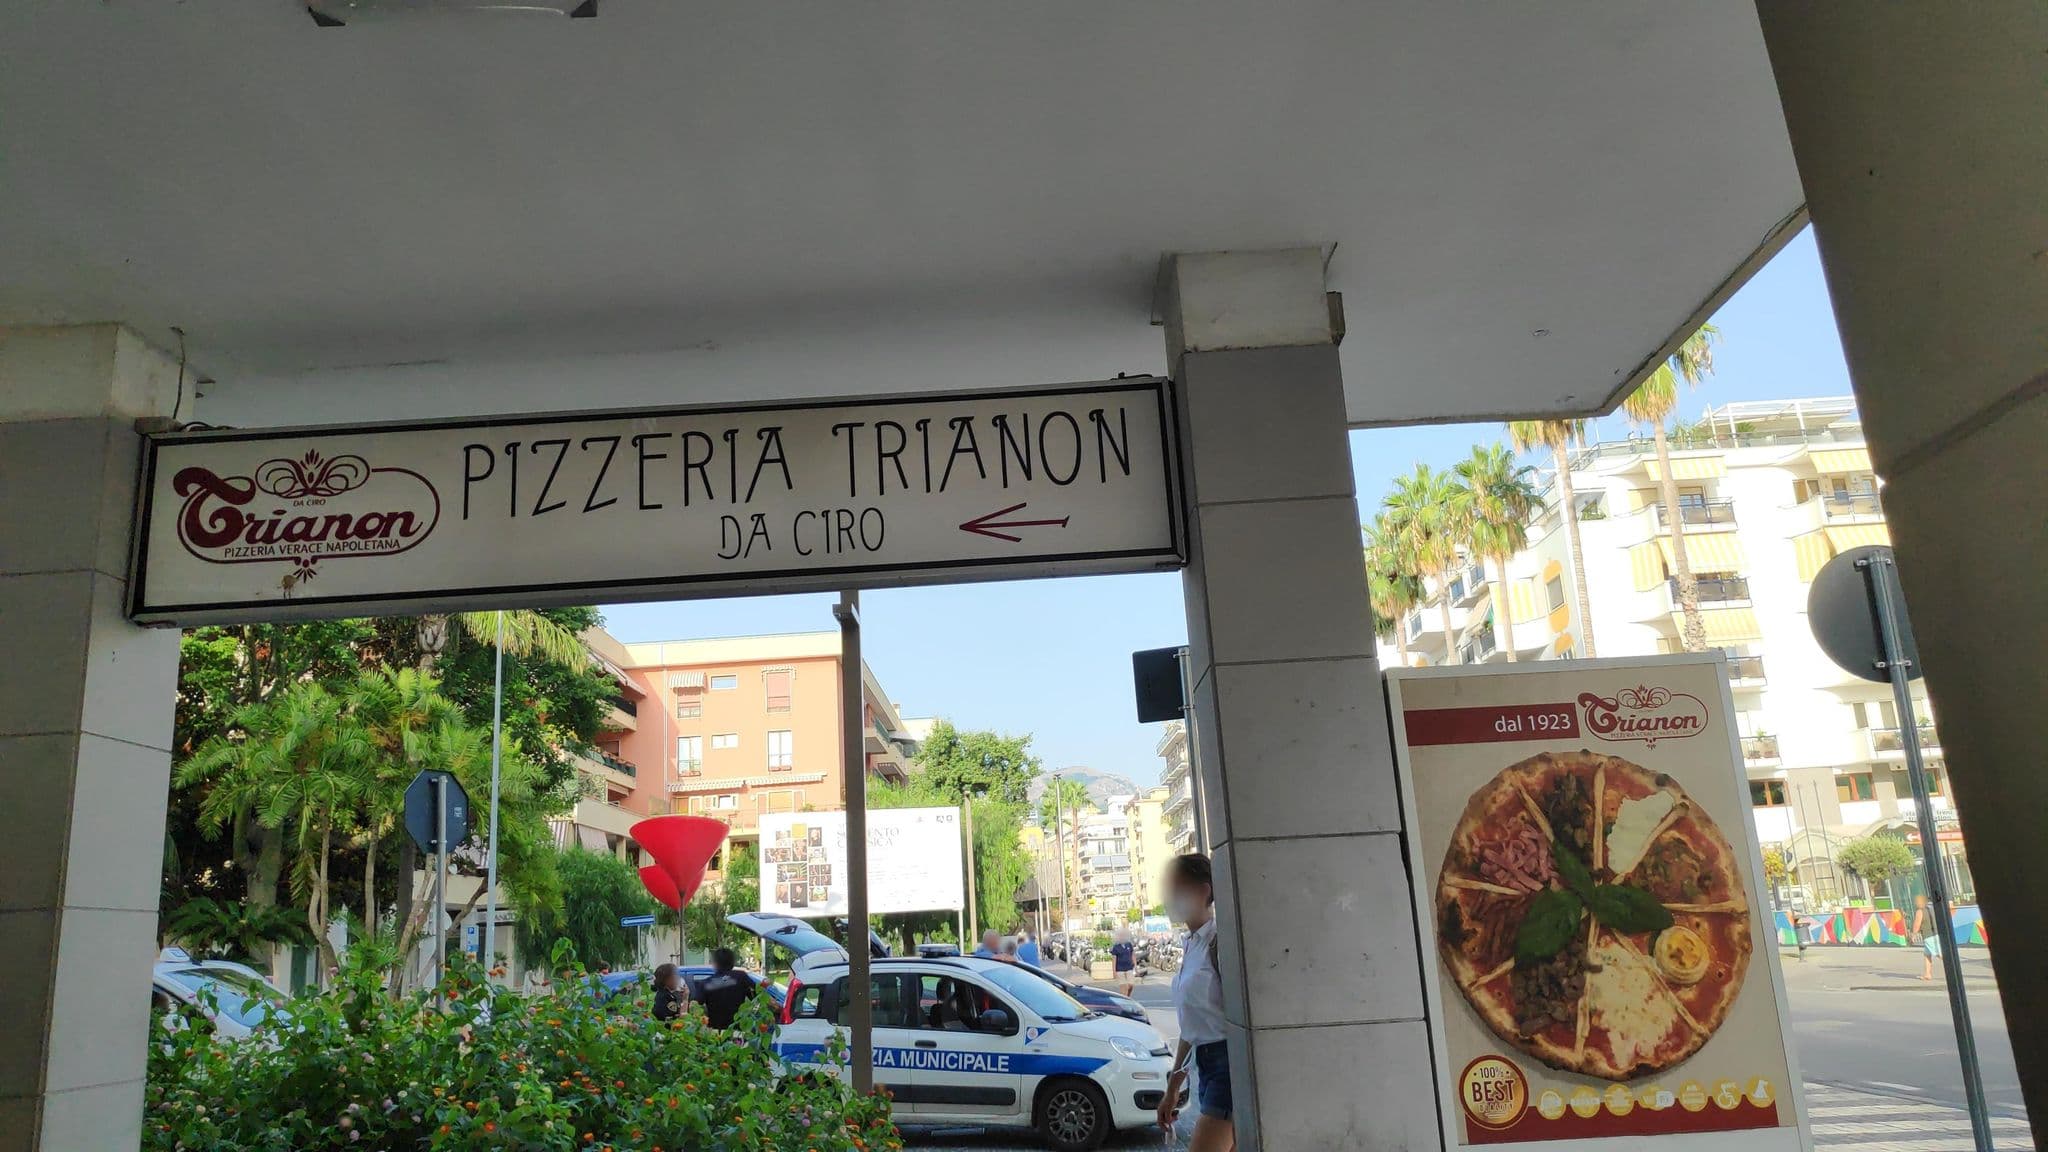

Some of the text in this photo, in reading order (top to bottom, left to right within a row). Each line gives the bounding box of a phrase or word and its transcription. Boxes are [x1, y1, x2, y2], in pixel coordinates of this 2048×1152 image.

[463, 407, 1131, 521] PIZZERIA TRIANON
[717, 507, 885, 559] DA CIRO
[224, 539, 400, 558] PIZZERIA VERACE NAPOLETANA
[1495, 713, 1571, 733] dal 1923
[900, 1049, 1009, 1072] MUNICIPALE
[1472, 1079, 1514, 1102] BEST
